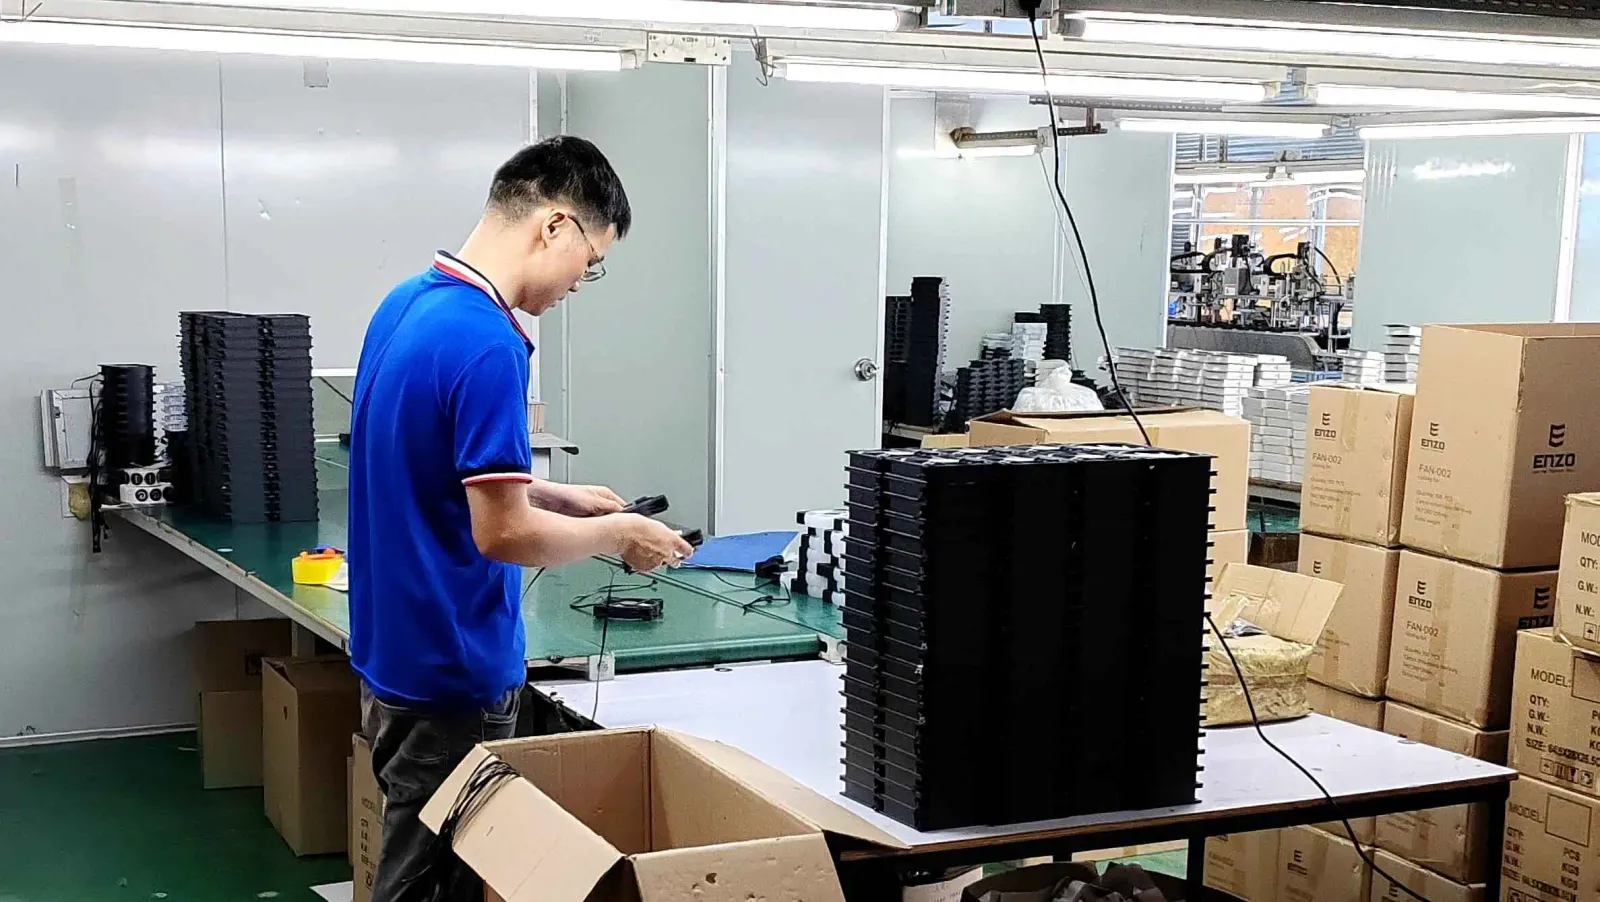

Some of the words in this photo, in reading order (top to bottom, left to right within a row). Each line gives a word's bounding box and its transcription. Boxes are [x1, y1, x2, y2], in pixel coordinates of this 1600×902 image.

[1312, 452, 1342, 464] FAN-002
[1533, 453, 1576, 469] ENZO
[1418, 464, 1452, 479] FAN-002
[1580, 556, 1598, 570] QTY:
[1406, 621, 1439, 637] FAN-002
[1531, 668, 1572, 688] MODEL:
[1529, 694, 1549, 708] QTY:
